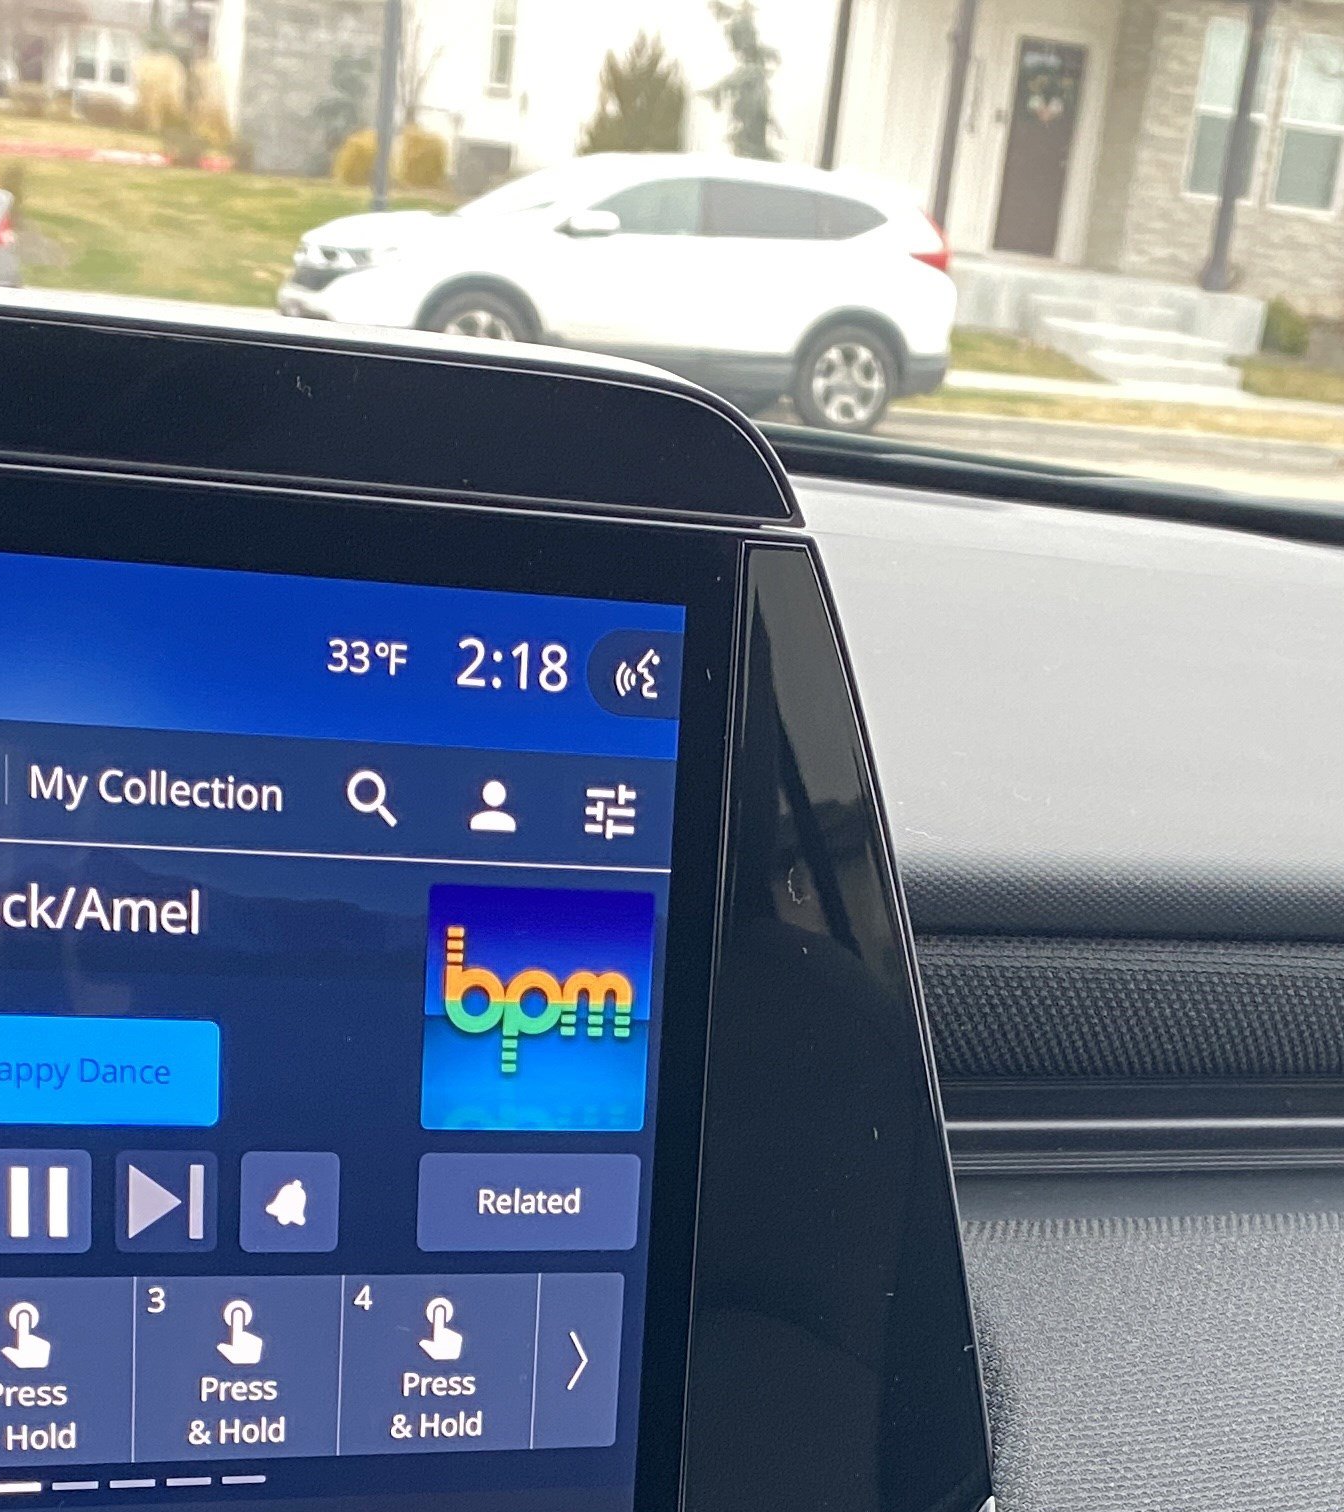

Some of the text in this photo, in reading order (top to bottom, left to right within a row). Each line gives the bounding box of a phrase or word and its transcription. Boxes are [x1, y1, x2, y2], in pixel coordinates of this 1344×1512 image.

[456, 637, 568, 693] 2:18
[30, 764, 283, 812] My Collection
[444, 926, 633, 1074] bpm
[78, 1057, 171, 1087] Dance
[478, 1187, 582, 1215] Related
[147, 1286, 166, 1314] 3
[353, 1284, 373, 1311] 4
[201, 1376, 278, 1402] Press
[403, 1372, 476, 1397] Press
[6, 1421, 77, 1451] Hold
[188, 1415, 286, 1445] & Hold
[390, 1410, 483, 1439] & Hold
